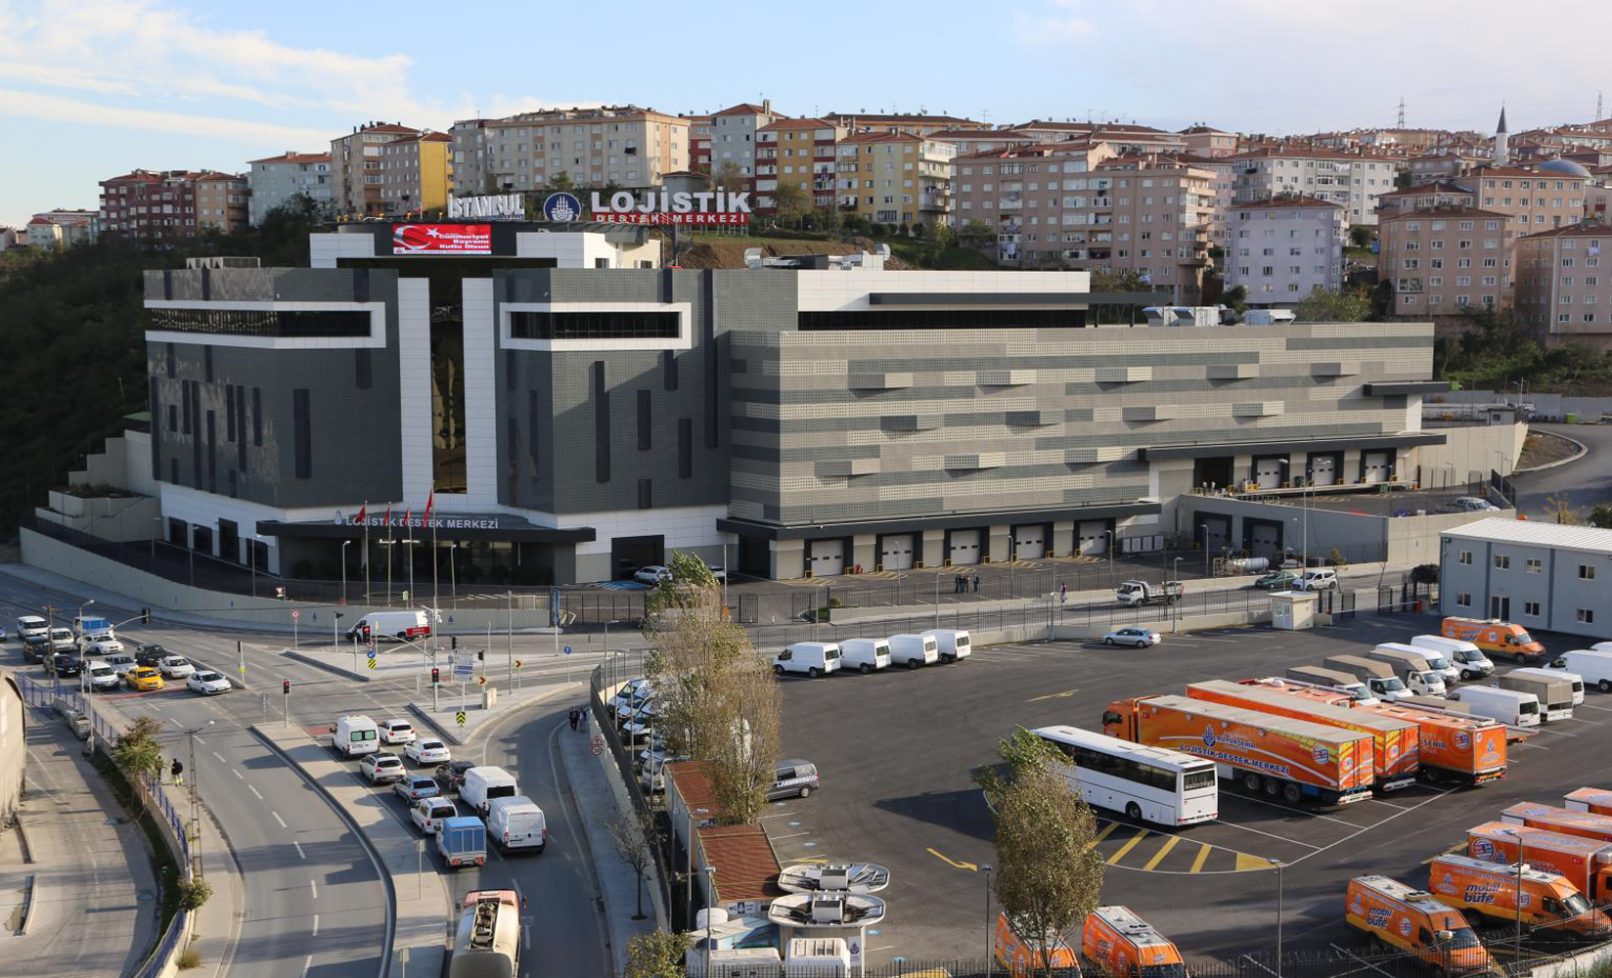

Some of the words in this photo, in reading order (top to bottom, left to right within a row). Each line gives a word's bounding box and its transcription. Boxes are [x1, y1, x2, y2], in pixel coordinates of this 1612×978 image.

[591, 186, 750, 213] LOJİSTİK
[596, 214, 659, 224] DESTEK
[673, 214, 745, 223] MERKEZİ
[400, 518, 443, 528] DESEK
[447, 518, 499, 529] MERKEZİ
[1465, 881, 1502, 894] mobil
[1464, 892, 1495, 905] büfe
